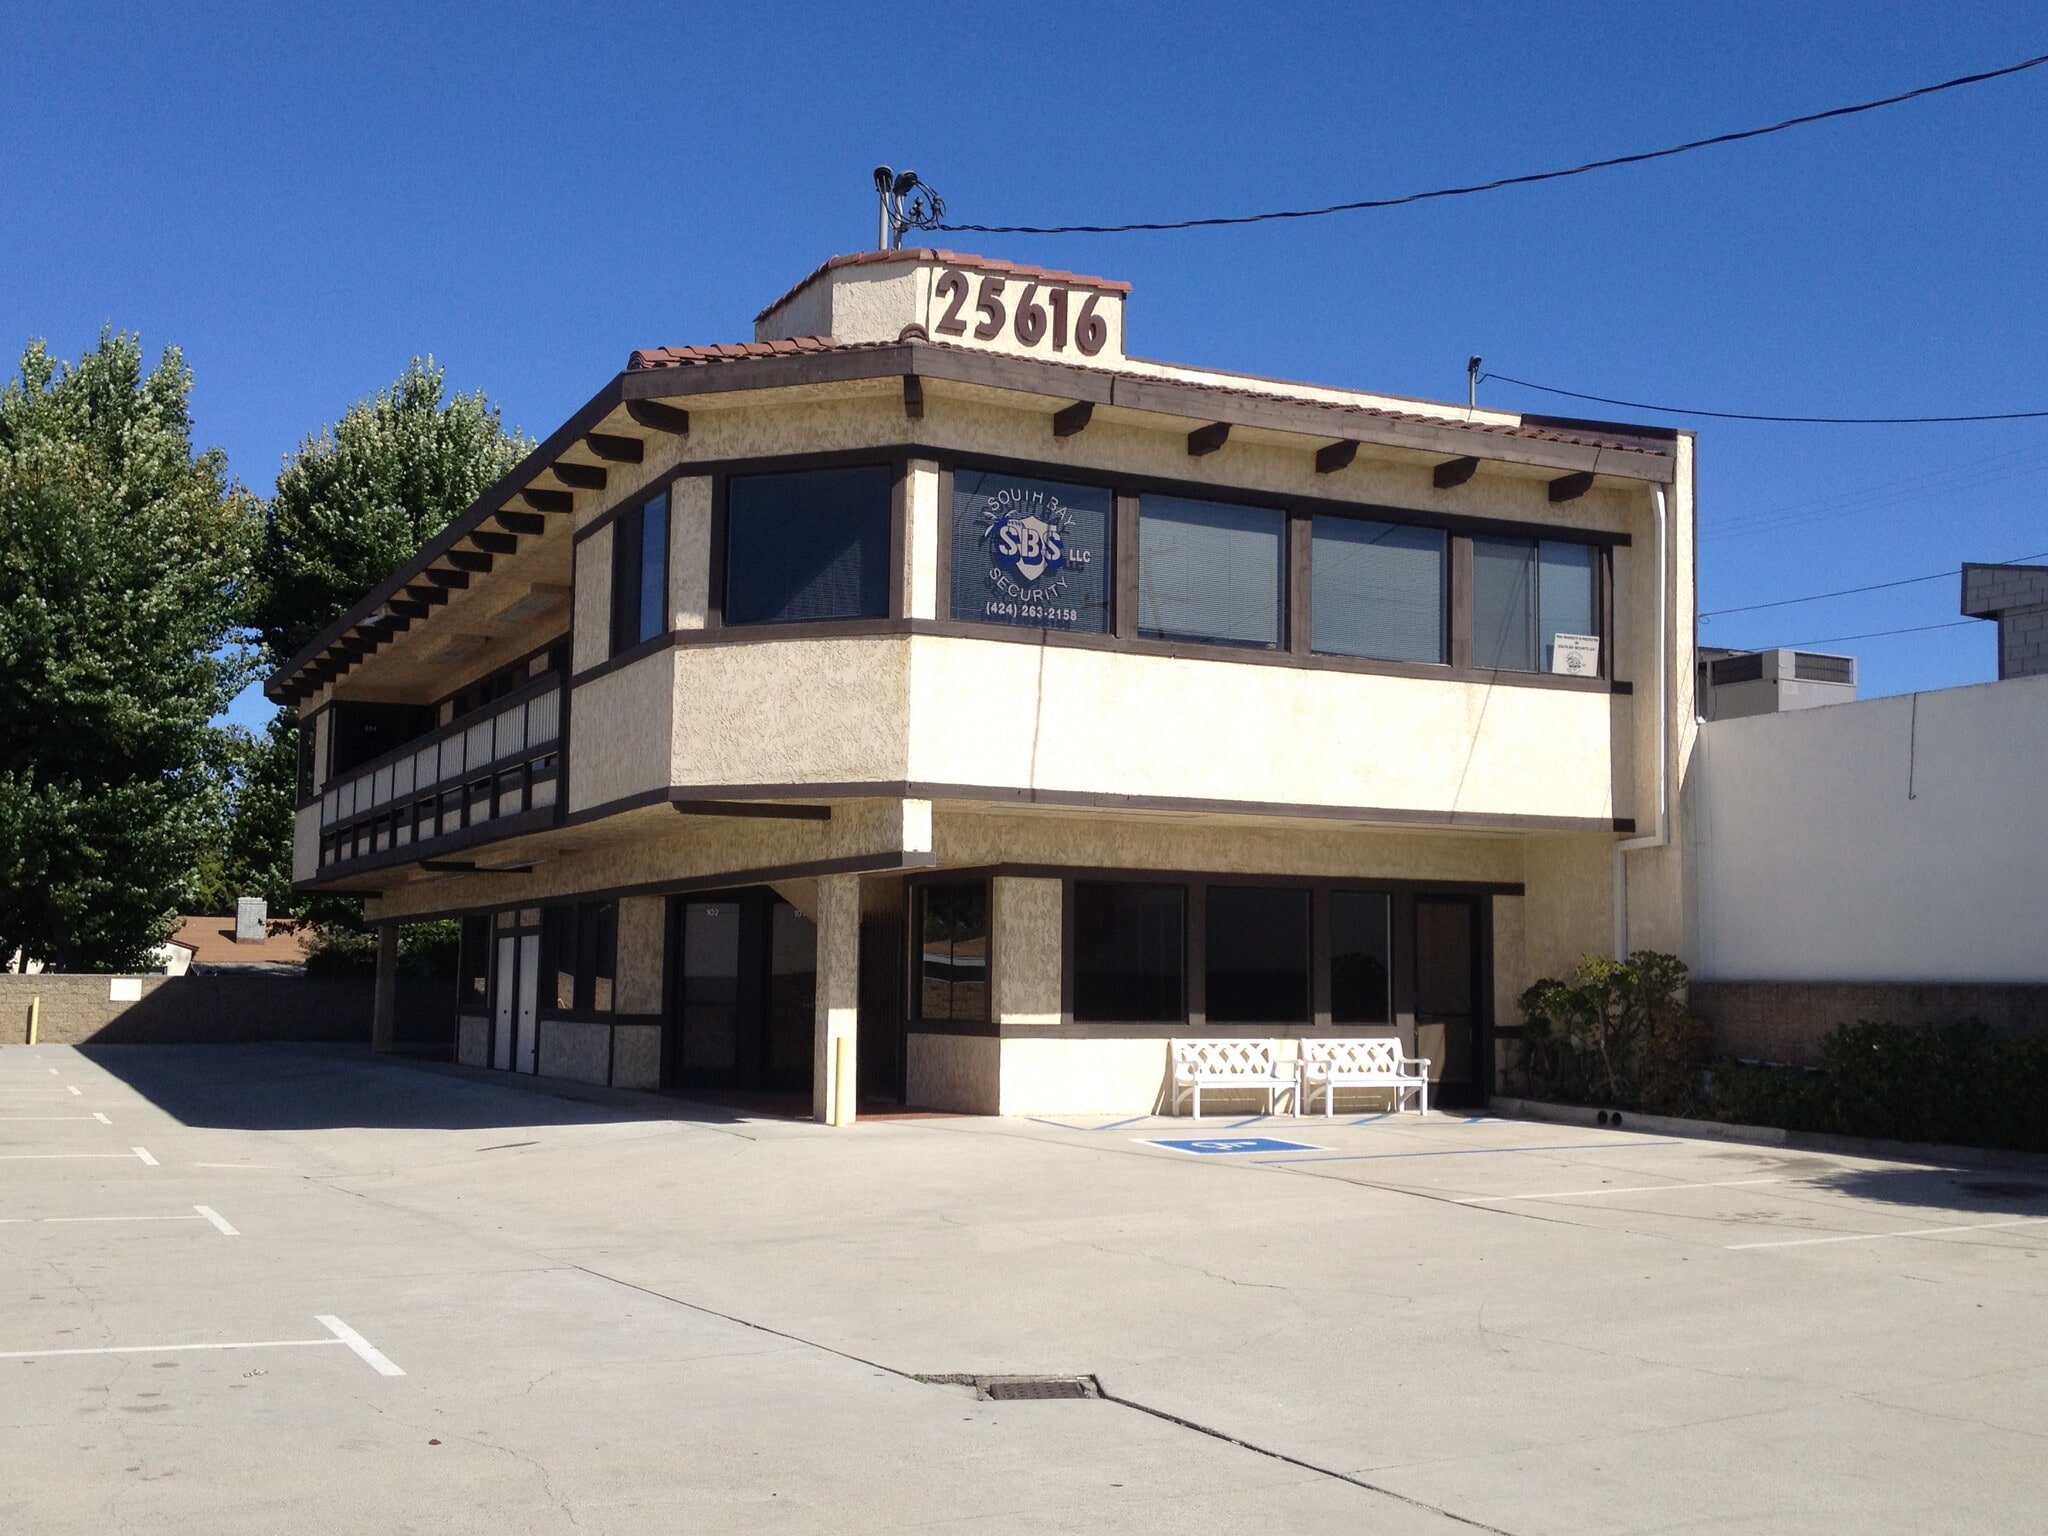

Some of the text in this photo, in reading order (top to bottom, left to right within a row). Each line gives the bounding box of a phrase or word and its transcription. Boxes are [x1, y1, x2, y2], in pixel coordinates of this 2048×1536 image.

[935, 270, 1107, 356] 25616
[1047, 496, 1077, 526] BAY
[999, 525, 1061, 560] SBS
[1069, 549, 1091, 563] LLC
[989, 567, 1068, 603] SECURITY
[986, 602, 1077, 621] (424) 263-2158
[706, 908, 720, 917] 102
